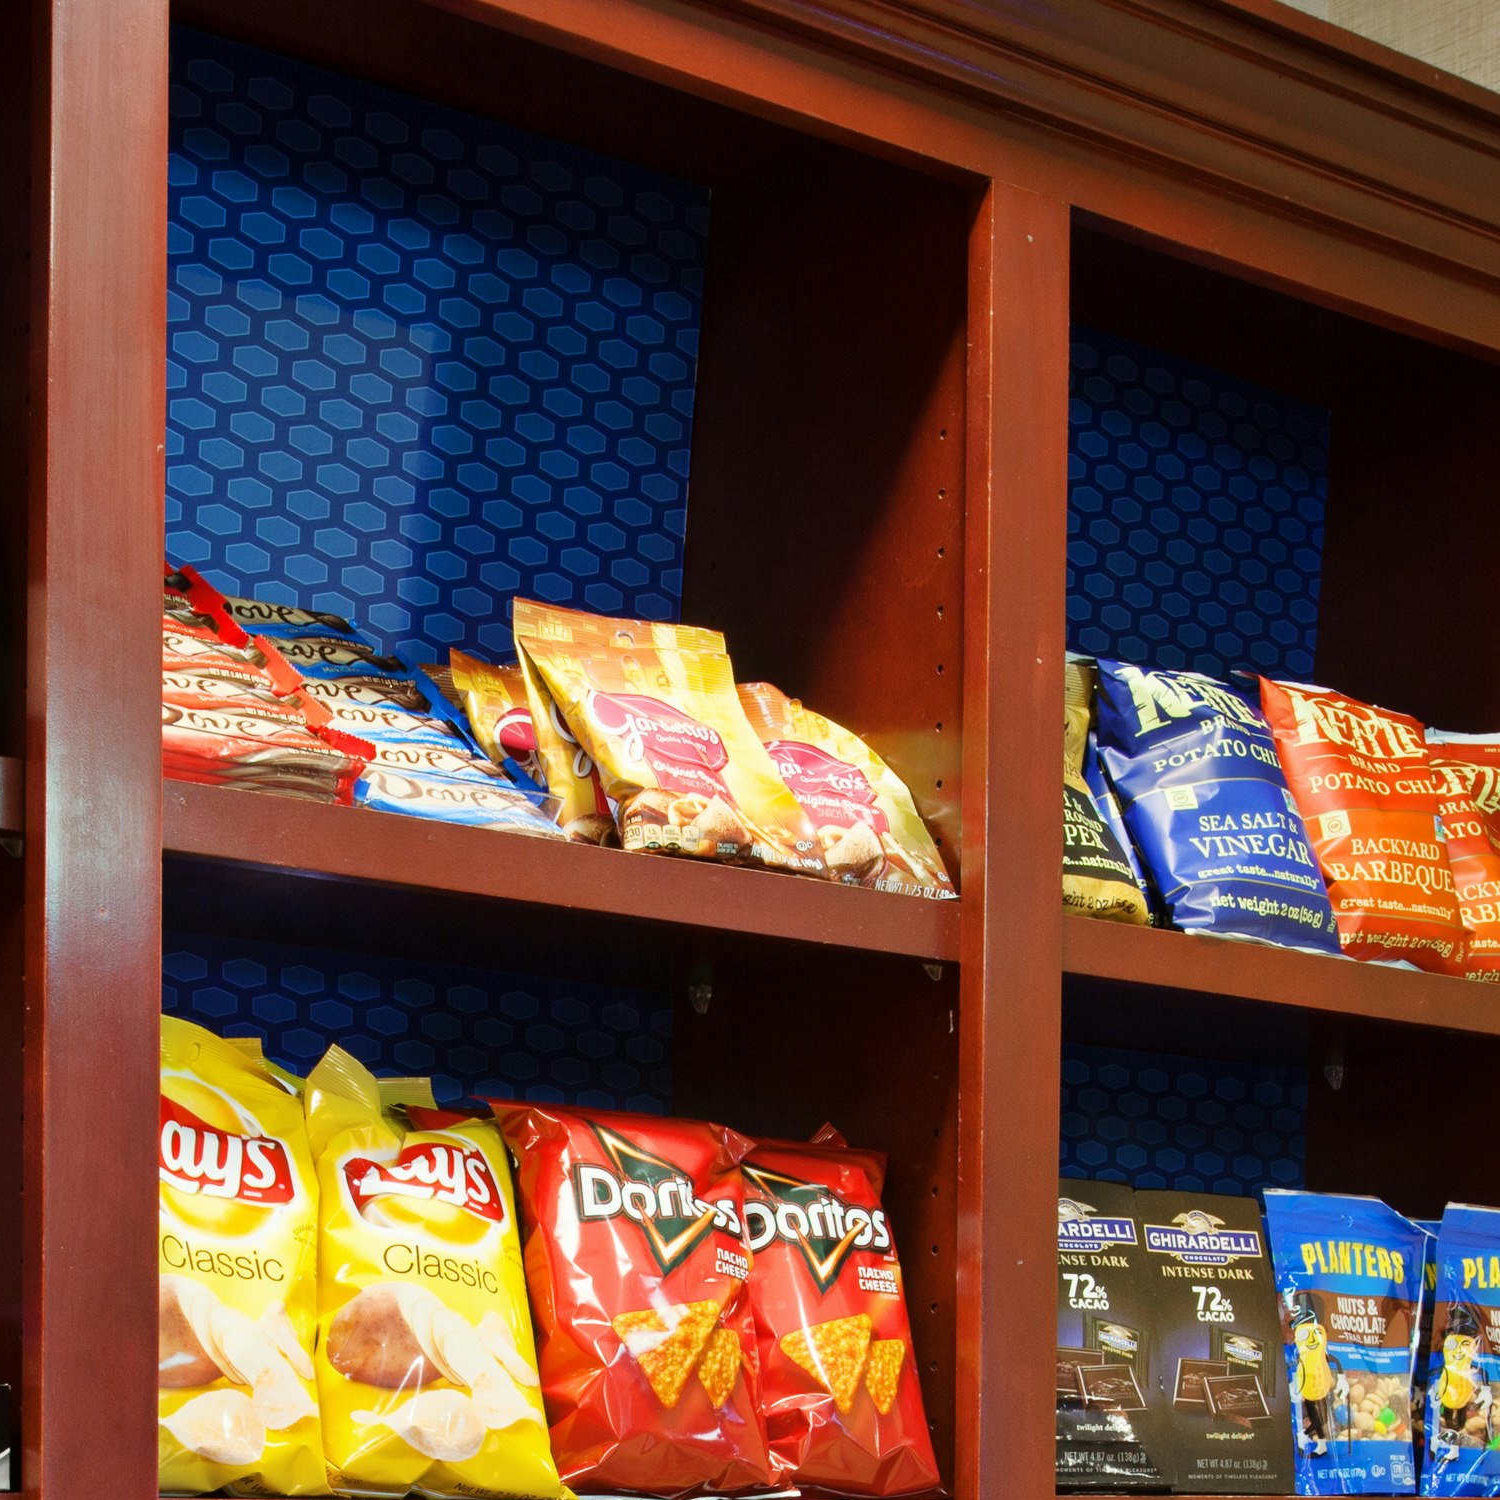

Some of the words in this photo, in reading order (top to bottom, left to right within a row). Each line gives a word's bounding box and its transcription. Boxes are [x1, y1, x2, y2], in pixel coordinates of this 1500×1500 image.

[1201, 718, 1251, 738] BRAND
[1153, 741, 1246, 774] POTATO
[1348, 753, 1401, 774] BRAND
[1309, 774, 1392, 797] POTATO
[1198, 814, 1239, 832] SEA
[1243, 811, 1285, 832] SALT
[1288, 818, 1299, 834] &
[1189, 835, 1315, 868] VINEGAR
[1351, 838, 1440, 861] BACKYARD
[1197, 865, 1234, 879] great
[1329, 860, 1455, 896] BARBEQUE
[744, 1198, 891, 1253] Doritos
[1150, 1231, 1258, 1253] GHIRARDELLI
[160, 1234, 285, 1282] Classic
[1184, 1254, 1225, 1262] CHOCOLATE
[1301, 1240, 1405, 1285] PLANTERS
[383, 1243, 499, 1296] Classic
[858, 1265, 895, 1281] NACHO
[1162, 1266, 1215, 1279] INTENSE
[1218, 1267, 1254, 1280] DARK
[859, 1278, 898, 1294] CHEESE
[1191, 1286, 1233, 1311] 72%
[1337, 1297, 1366, 1314] NUTS
[1368, 1298, 1378, 1314] &
[1196, 1311, 1235, 1322] CACAO
[1330, 1313, 1386, 1335] CHOCOLATE
